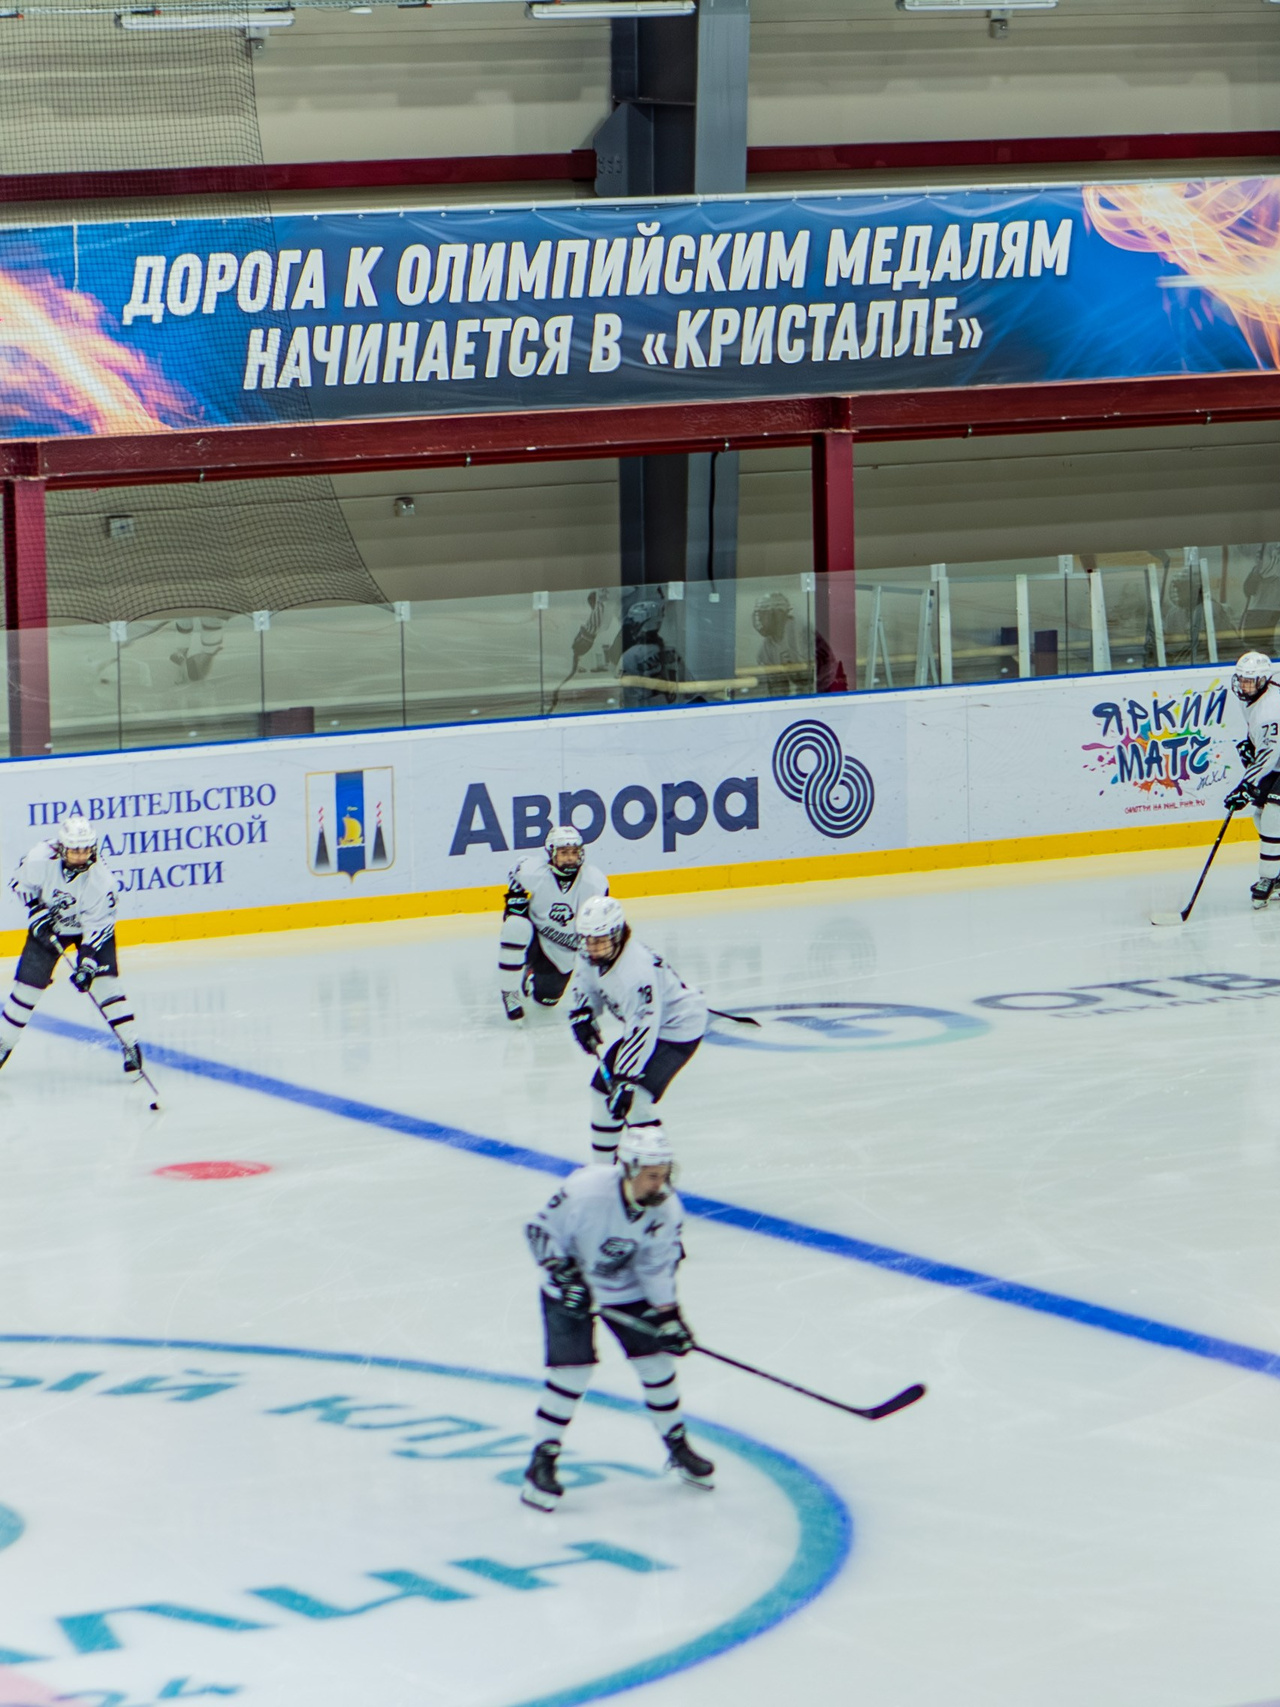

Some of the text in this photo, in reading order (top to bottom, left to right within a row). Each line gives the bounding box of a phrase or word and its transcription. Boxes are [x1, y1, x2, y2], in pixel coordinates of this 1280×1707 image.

[122, 218, 1073, 326] ДОРОГА К ОЛИМПИЙСКИМ МЕДАЛЯМ
[243, 297, 984, 390] НАЧИНАЕТСЯ В «КРИСТАЛЛЕ»
[1092, 685, 1228, 737] ЯРКИЙ
[1261, 722, 1279, 738] 73
[28, 783, 277, 826] ПРАВИТЕЛЬСТВО
[448, 776, 760, 856] Аврора
[100, 814, 268, 857] АЛИНСКОЙ
[111, 860, 225, 893] БЛАСТИ
